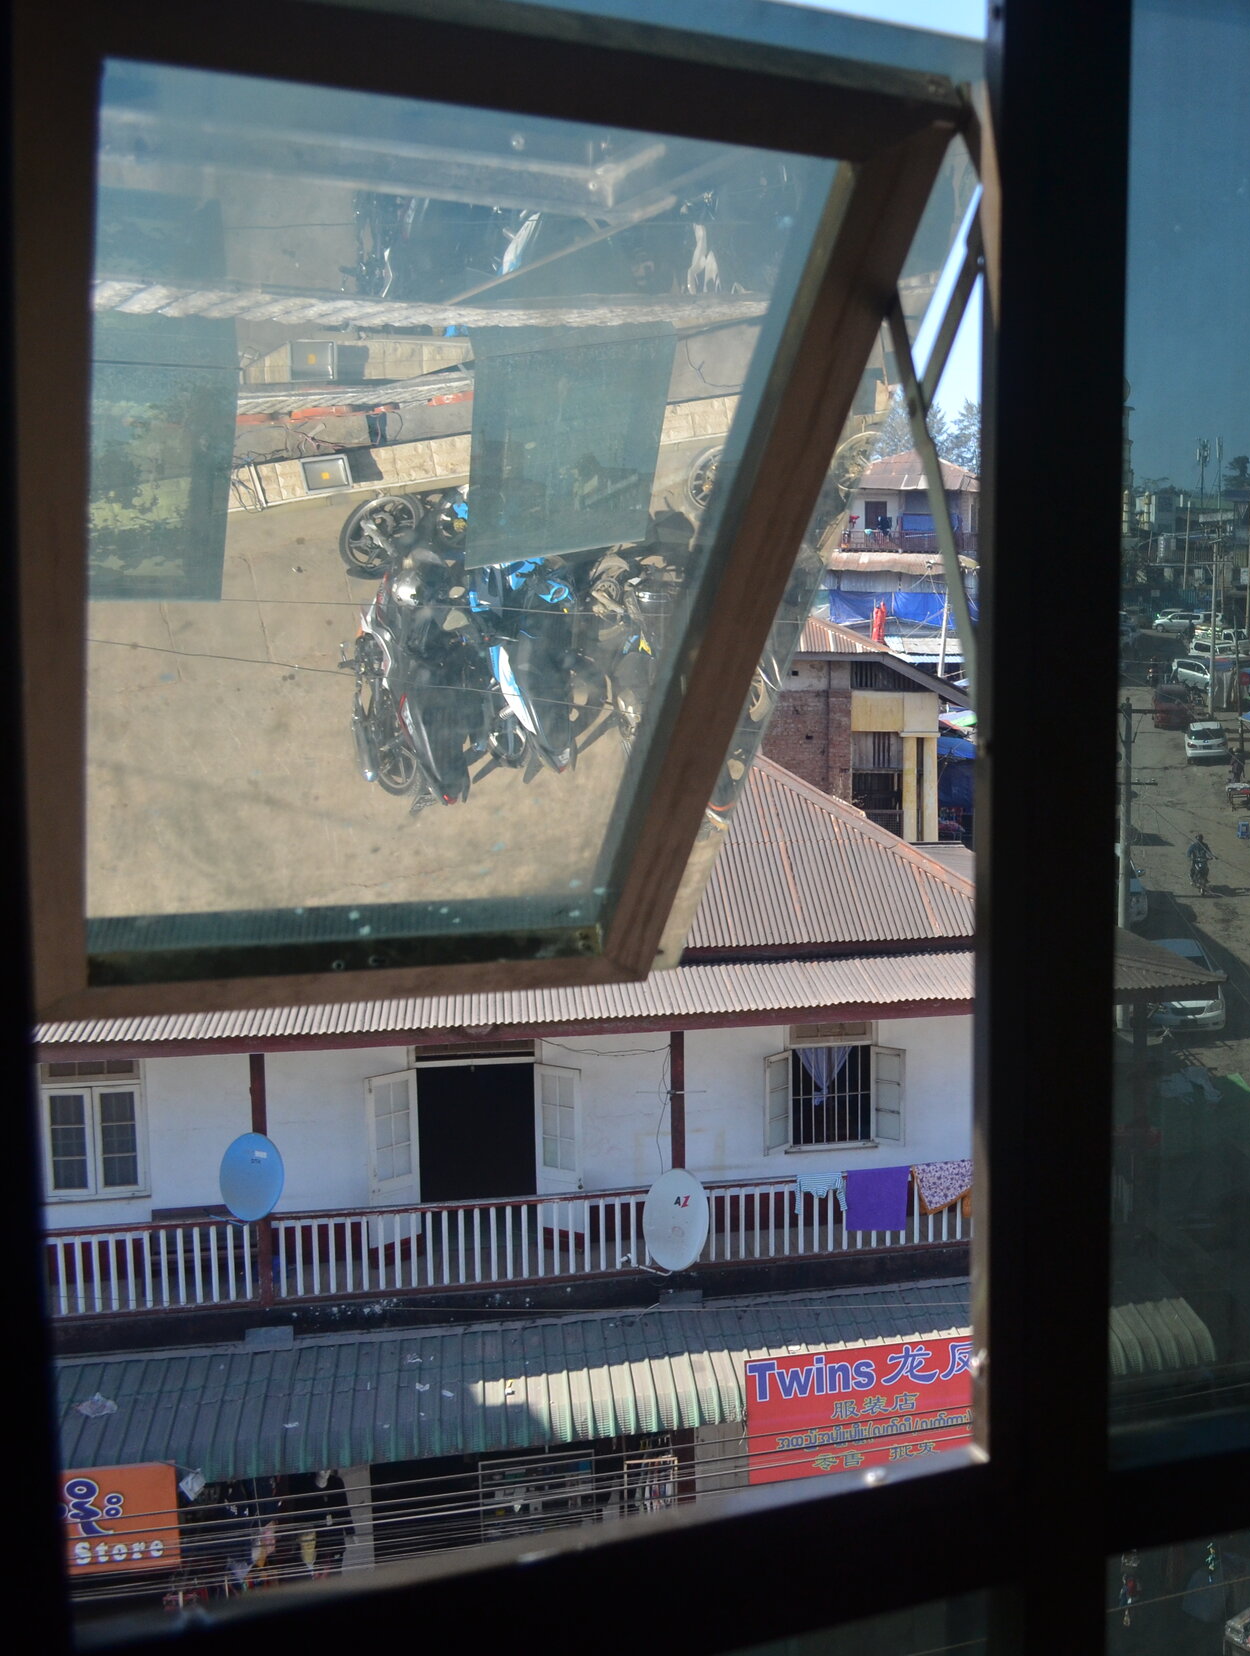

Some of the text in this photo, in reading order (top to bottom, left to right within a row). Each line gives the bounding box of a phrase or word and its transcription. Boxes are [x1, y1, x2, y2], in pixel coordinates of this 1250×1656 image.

[673, 1195, 691, 1209] AZ
[747, 1355, 876, 1402] Twins
[830, 1392, 920, 1419] 服装店
[812, 1441, 941, 1471] 零售 批发
[74, 1540, 165, 1566] Store
